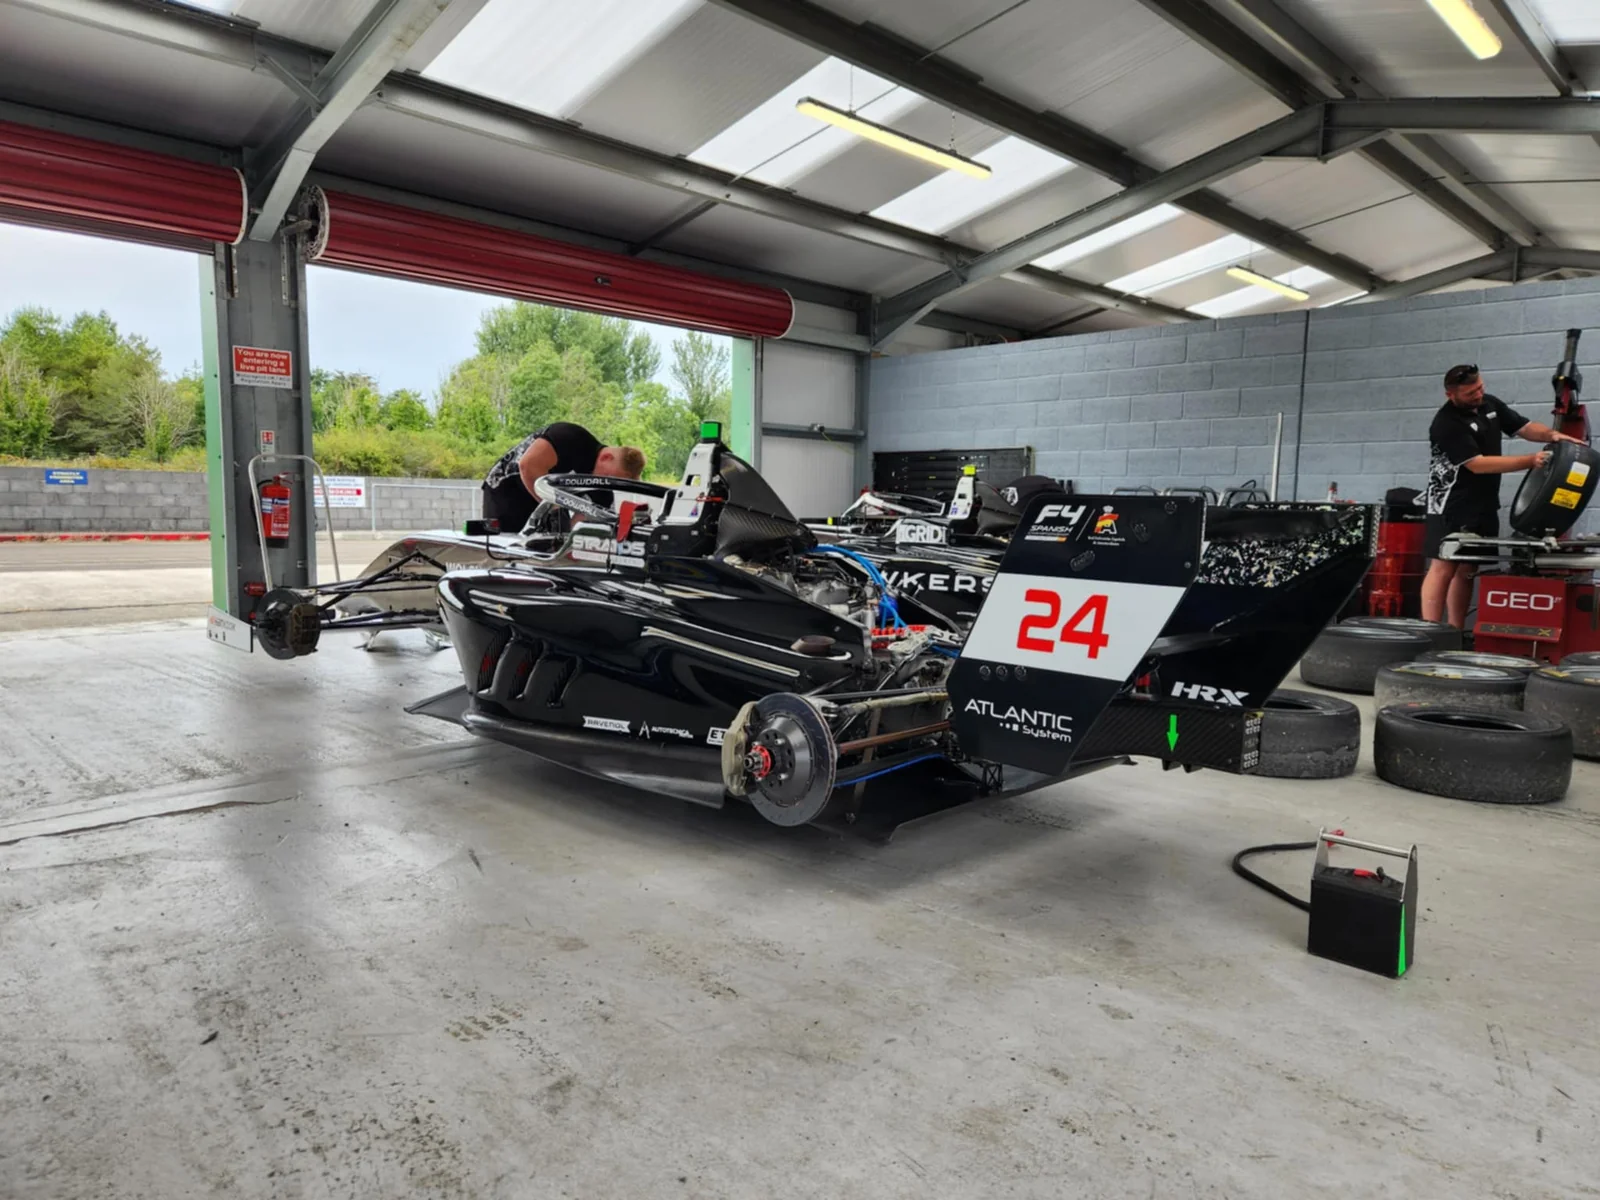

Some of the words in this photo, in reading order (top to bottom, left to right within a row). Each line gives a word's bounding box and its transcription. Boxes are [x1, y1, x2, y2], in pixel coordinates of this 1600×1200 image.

[237, 348, 255, 357] You
[270, 352, 288, 360] now
[243, 357, 278, 367] entering
[240, 362, 256, 371] live
[256, 365, 268, 373] pit
[269, 366, 287, 374] lane
[564, 478, 611, 486] DOWDALL
[1034, 504, 1087, 526] F4
[1029, 524, 1074, 534] SPANISH
[1486, 590, 1555, 611] GEO
[1016, 588, 1110, 660] 24
[1171, 681, 1250, 706] HRX
[964, 698, 1073, 733] ATLANTIC
[1022, 724, 1073, 743] System
